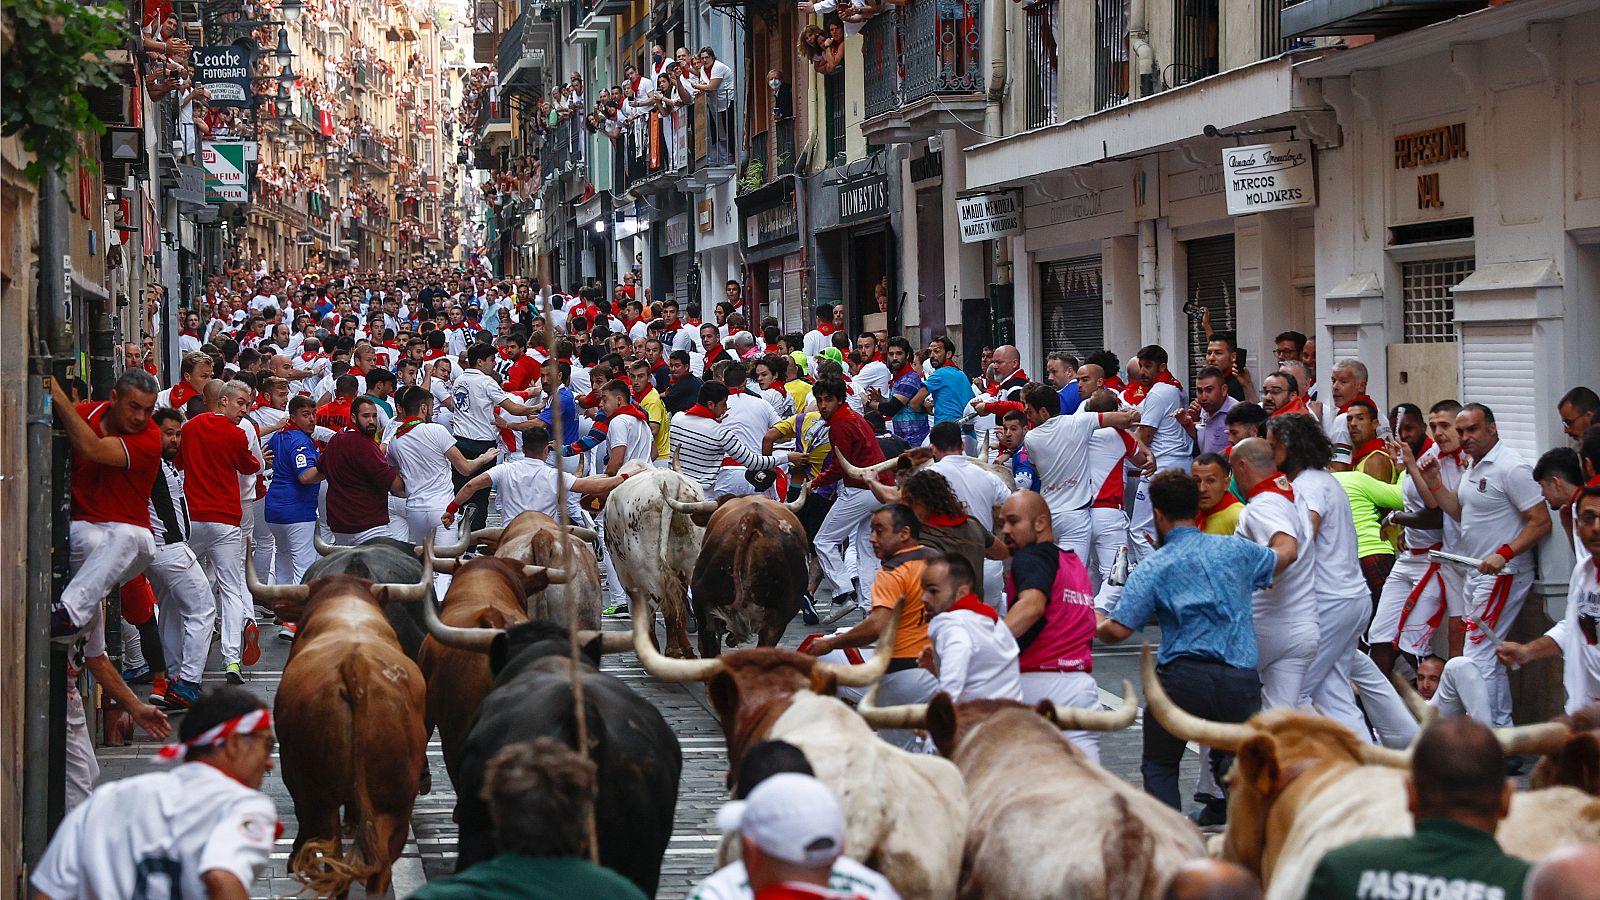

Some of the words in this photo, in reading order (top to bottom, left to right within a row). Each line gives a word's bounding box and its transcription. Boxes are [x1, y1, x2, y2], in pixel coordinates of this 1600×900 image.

[193, 50, 240, 67] Leache
[203, 67, 247, 79] FOTOGRAFO
[1233, 176, 1275, 191] MARCOS
[962, 203, 983, 220] AMADO
[985, 198, 1015, 216] MENDOZA
[964, 223, 985, 237] MARCOS
[986, 222, 990, 233] Y
[991, 217, 1018, 232] MOLDURAS
